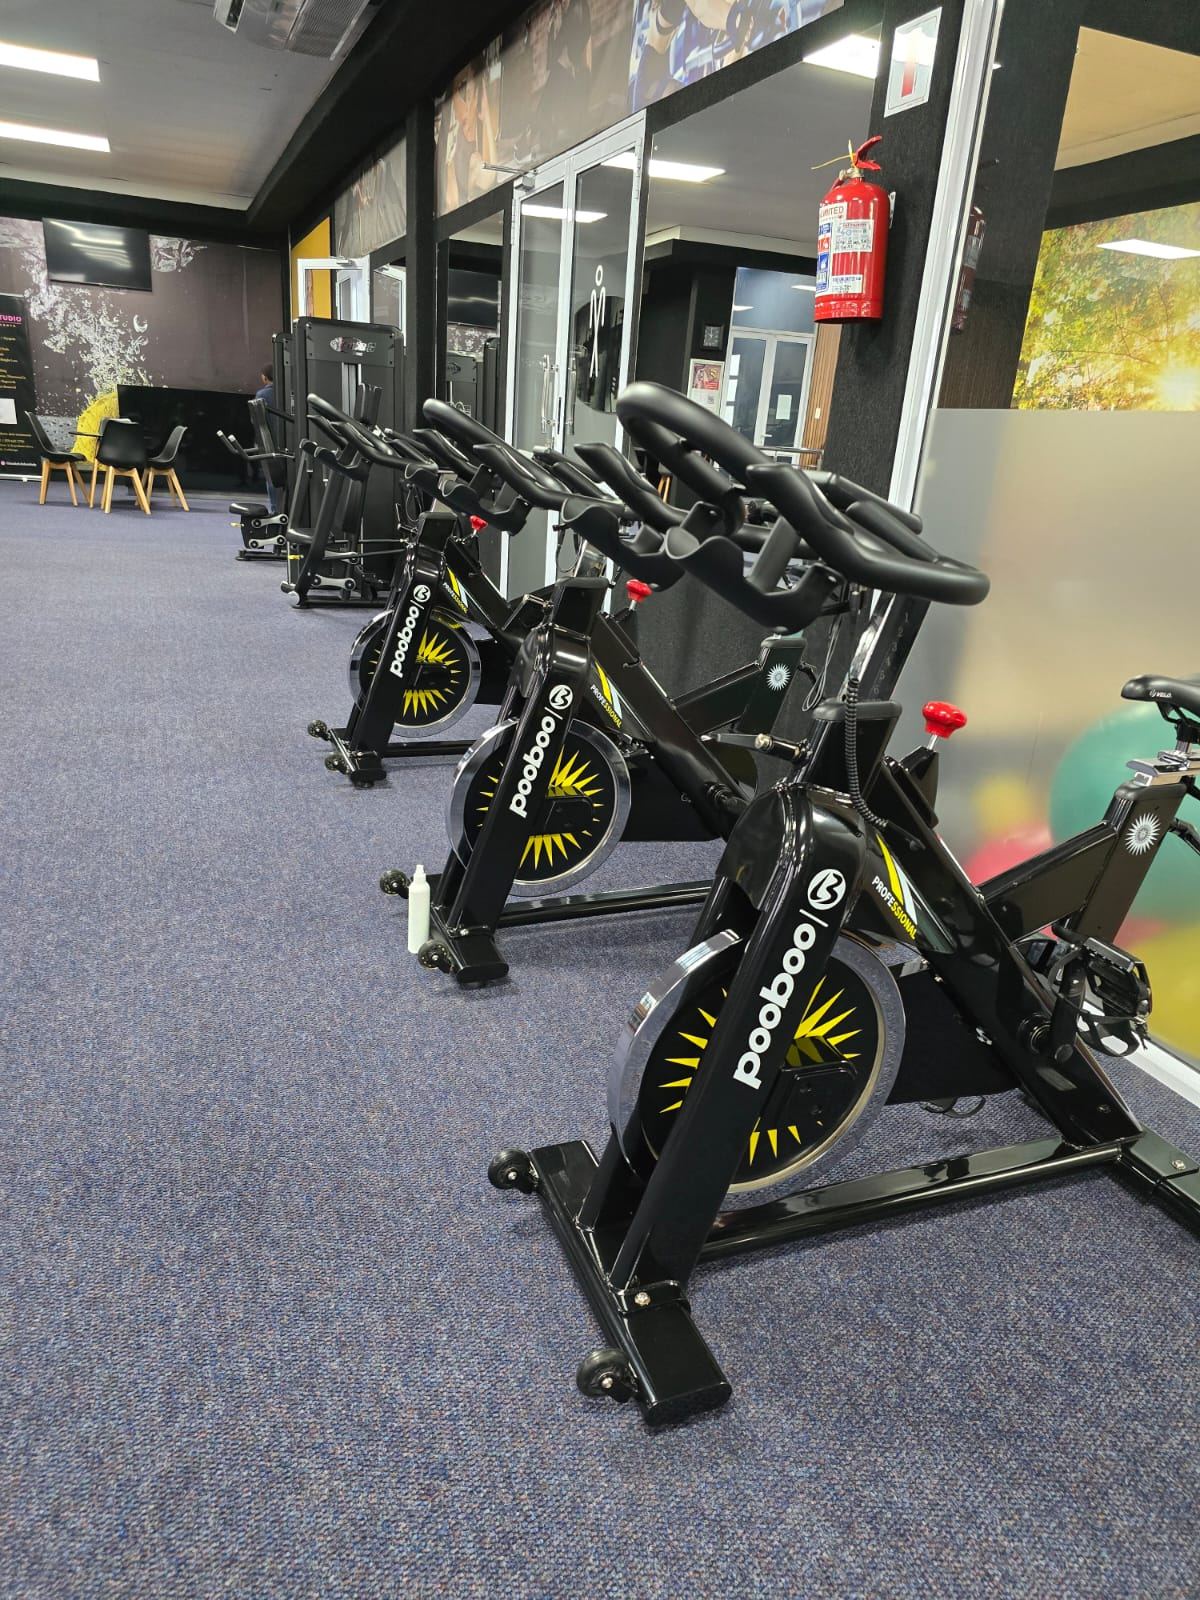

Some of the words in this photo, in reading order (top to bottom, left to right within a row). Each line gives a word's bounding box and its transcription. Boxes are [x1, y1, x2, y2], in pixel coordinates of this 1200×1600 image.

[390, 606, 420, 678] pooboo
[590, 684, 623, 728] PROFESSIONAL
[509, 715, 556, 818] pooboo
[871, 875, 918, 939] PROFESSIONAL
[733, 923, 816, 1089] pooboo
